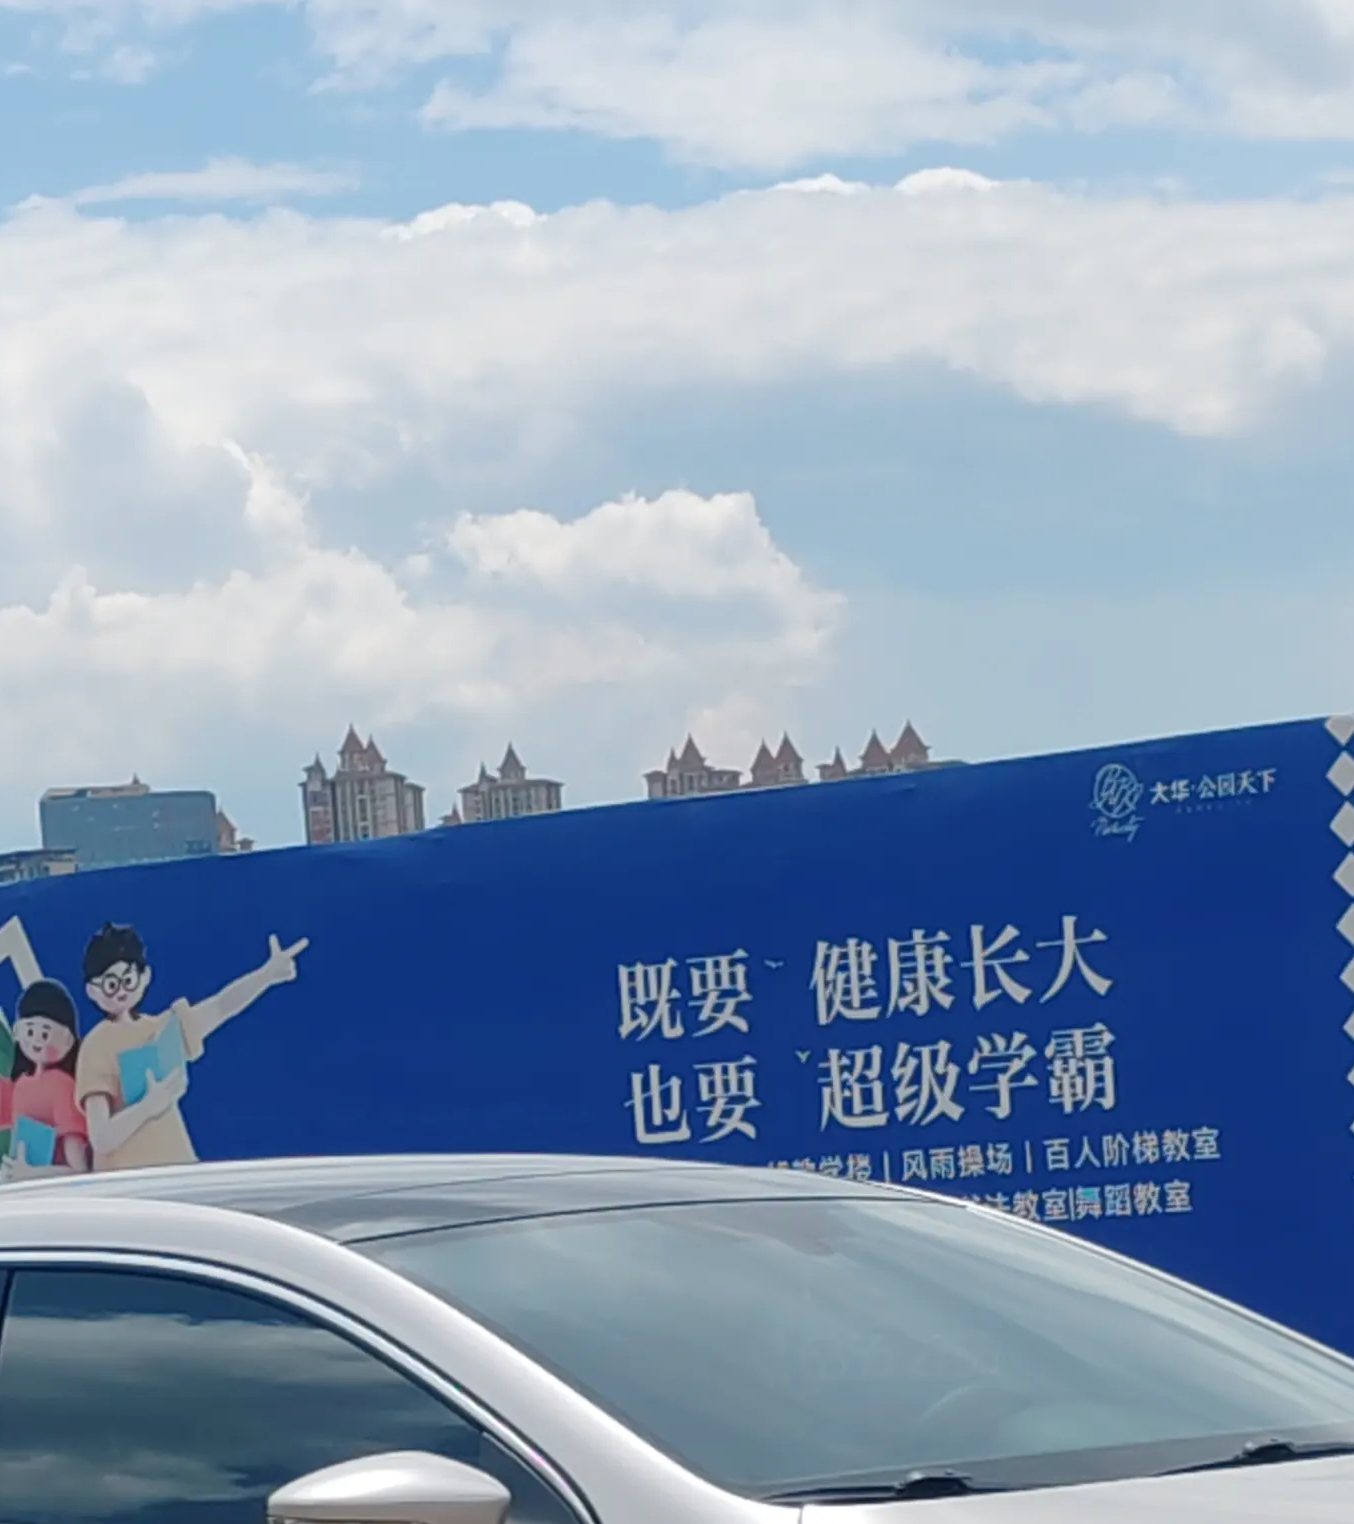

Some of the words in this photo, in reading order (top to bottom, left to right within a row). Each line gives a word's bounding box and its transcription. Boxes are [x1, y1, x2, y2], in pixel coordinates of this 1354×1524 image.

[616, 948, 753, 1042] 既要
[809, 915, 1114, 1026] 健康长大
[623, 1055, 763, 1145] 也要
[818, 1022, 1117, 1132] 超级学霸
